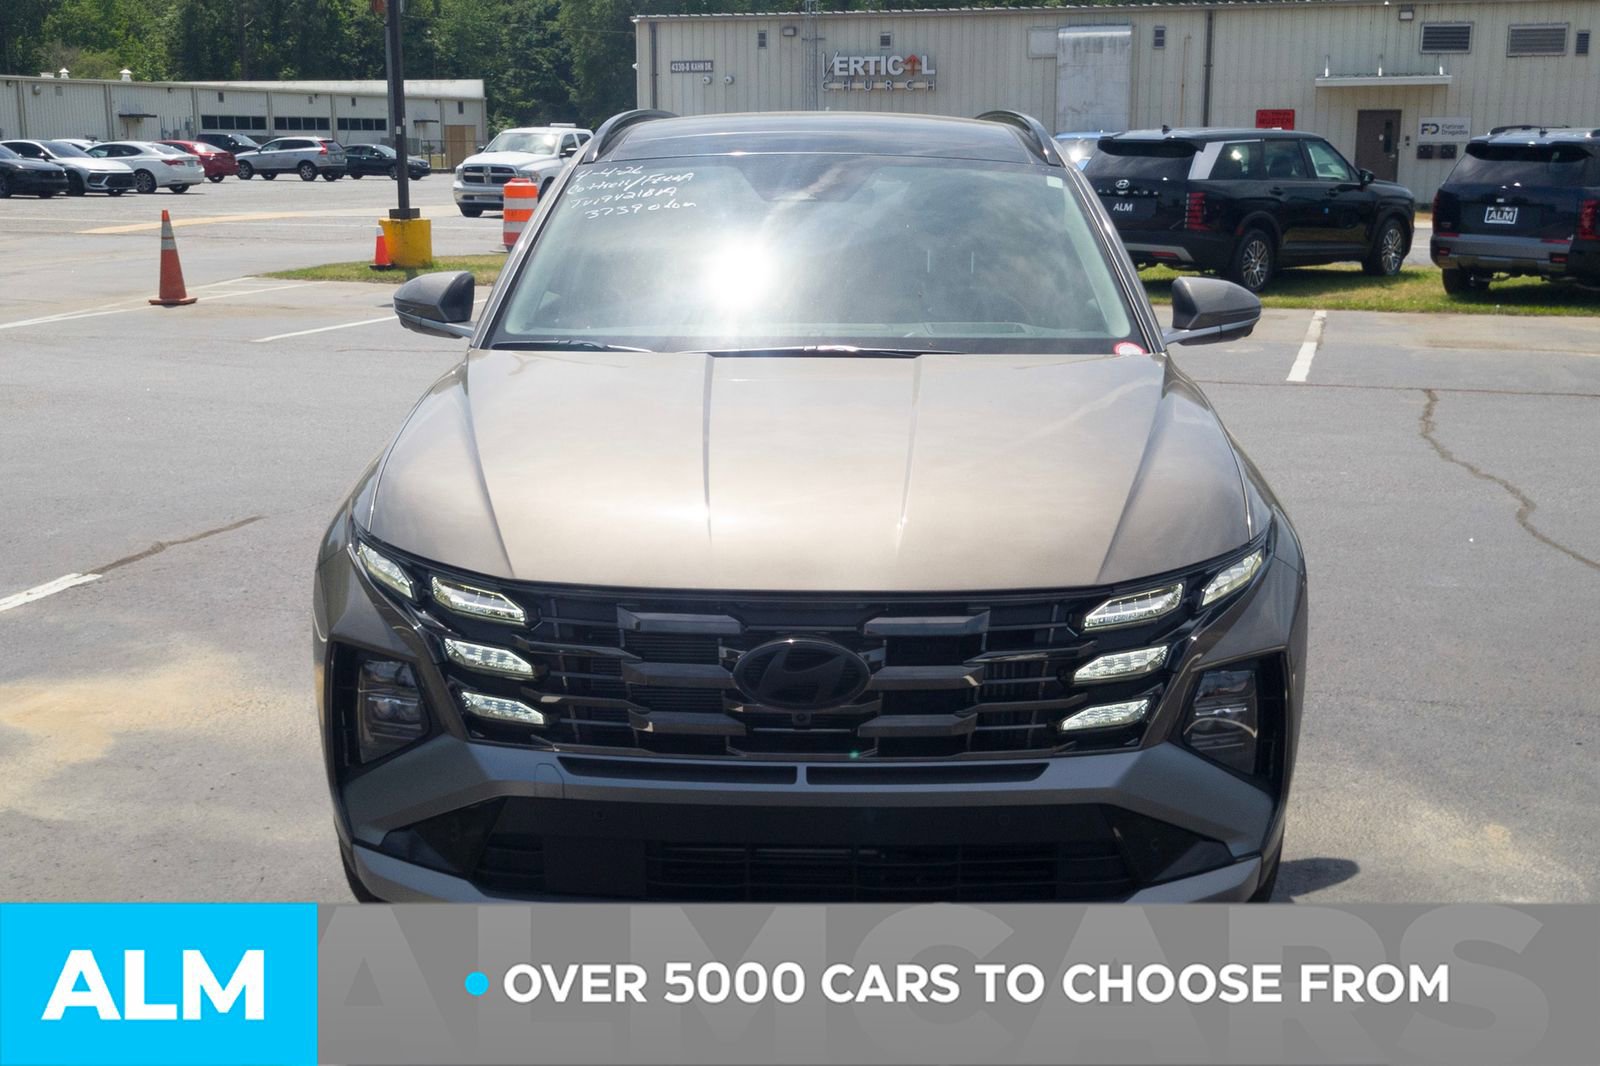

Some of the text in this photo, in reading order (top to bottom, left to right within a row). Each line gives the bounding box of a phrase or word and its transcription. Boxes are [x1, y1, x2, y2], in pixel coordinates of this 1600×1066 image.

[822, 80, 935, 91] CHURCH
[1113, 203, 1133, 212] ALM
[1488, 210, 1514, 220] ALM
